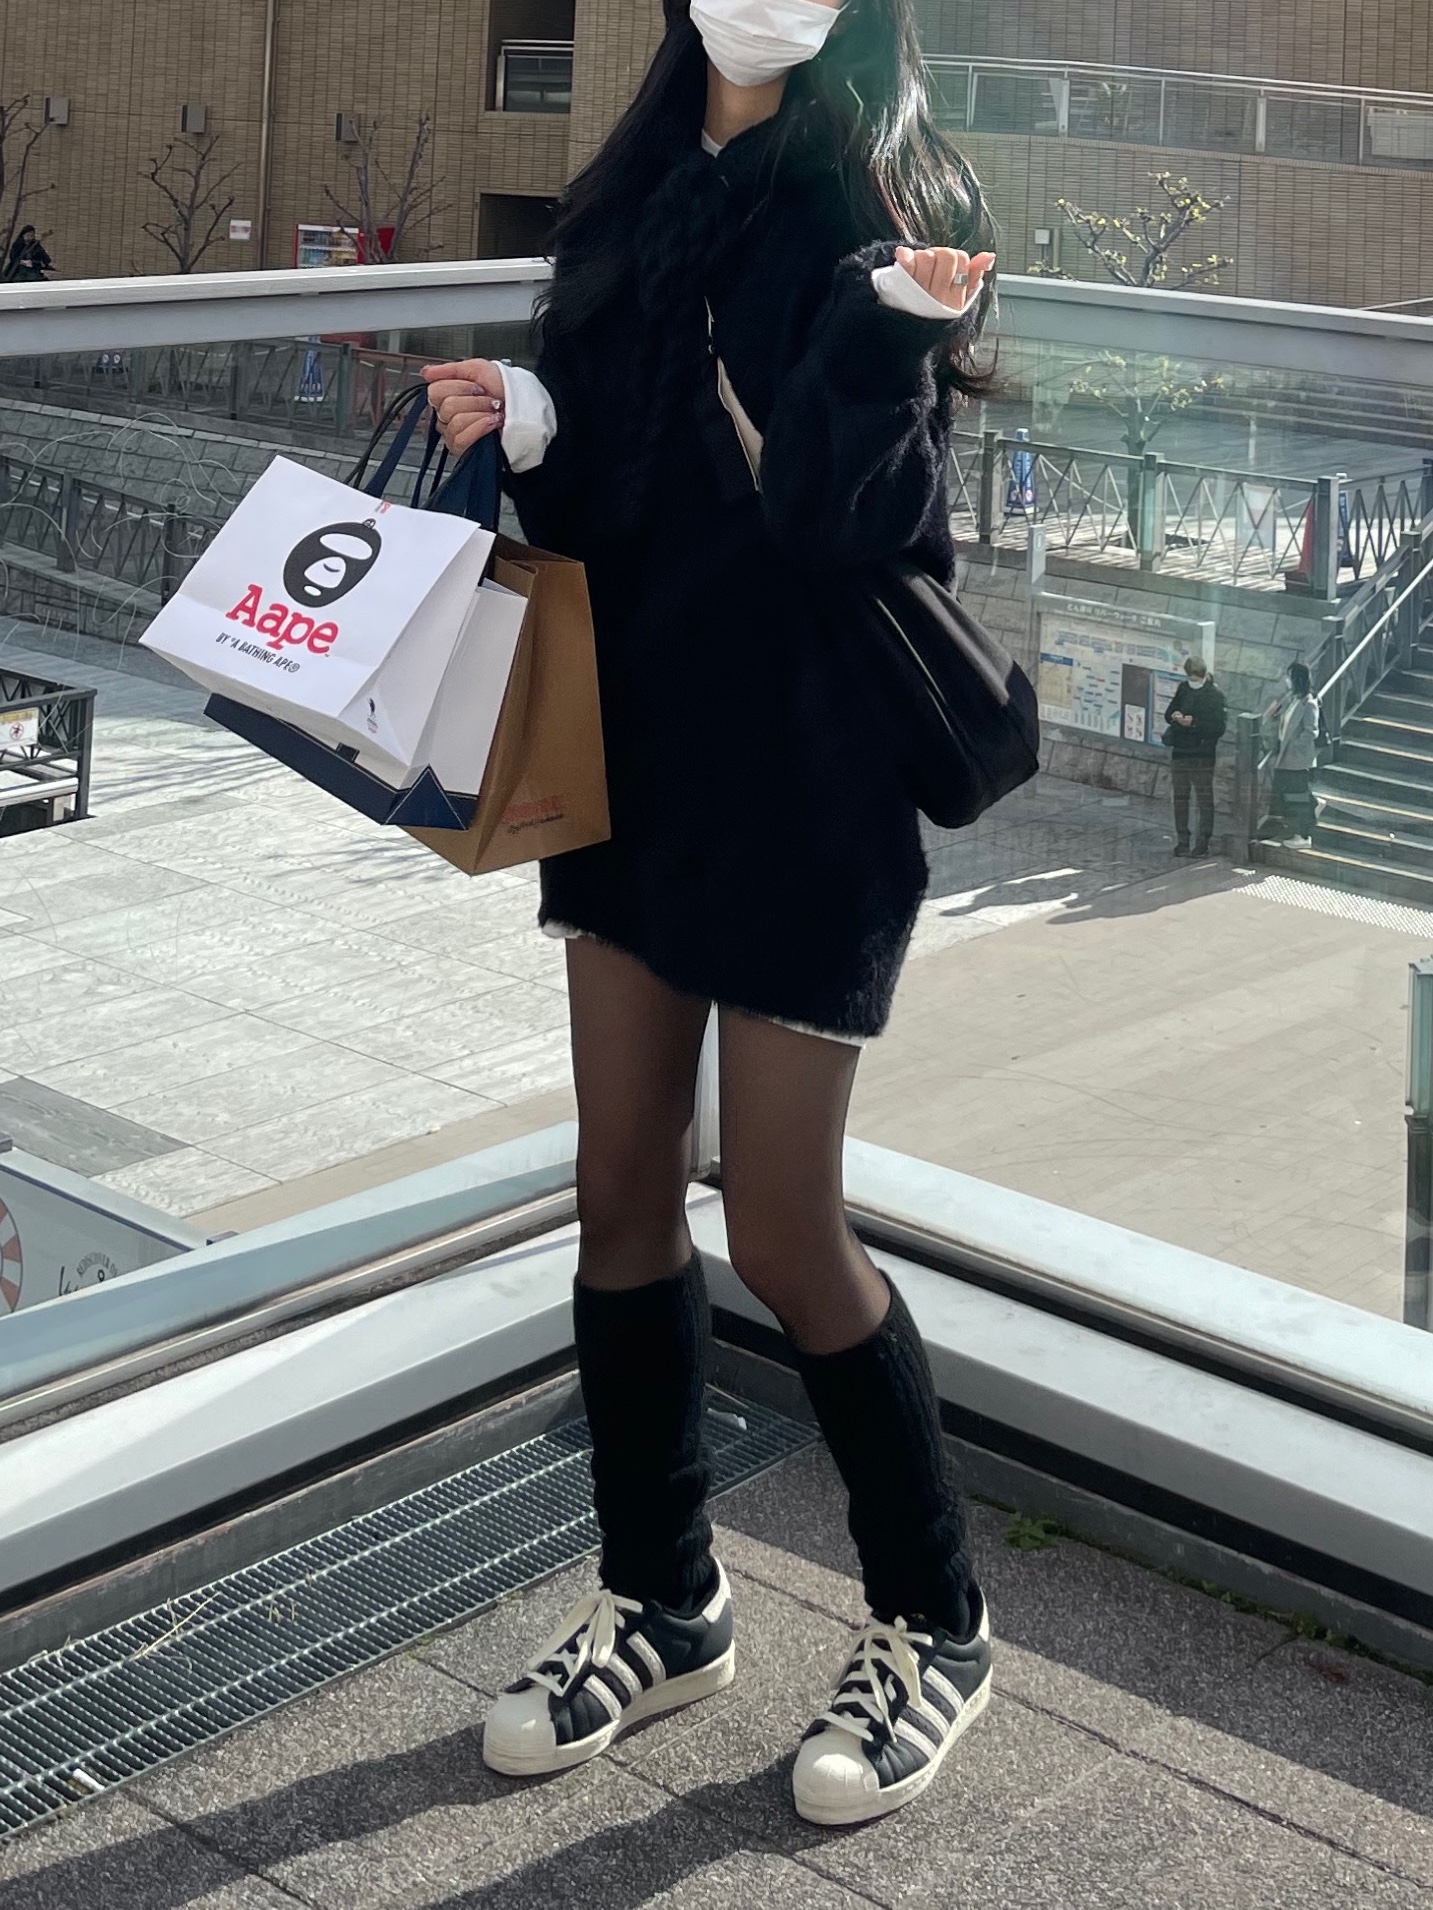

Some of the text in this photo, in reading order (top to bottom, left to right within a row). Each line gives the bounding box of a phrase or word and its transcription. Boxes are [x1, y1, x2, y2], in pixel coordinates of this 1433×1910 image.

[225, 583, 339, 654] Aape
[215, 632, 231, 645] BY
[239, 641, 276, 663] BATHING
